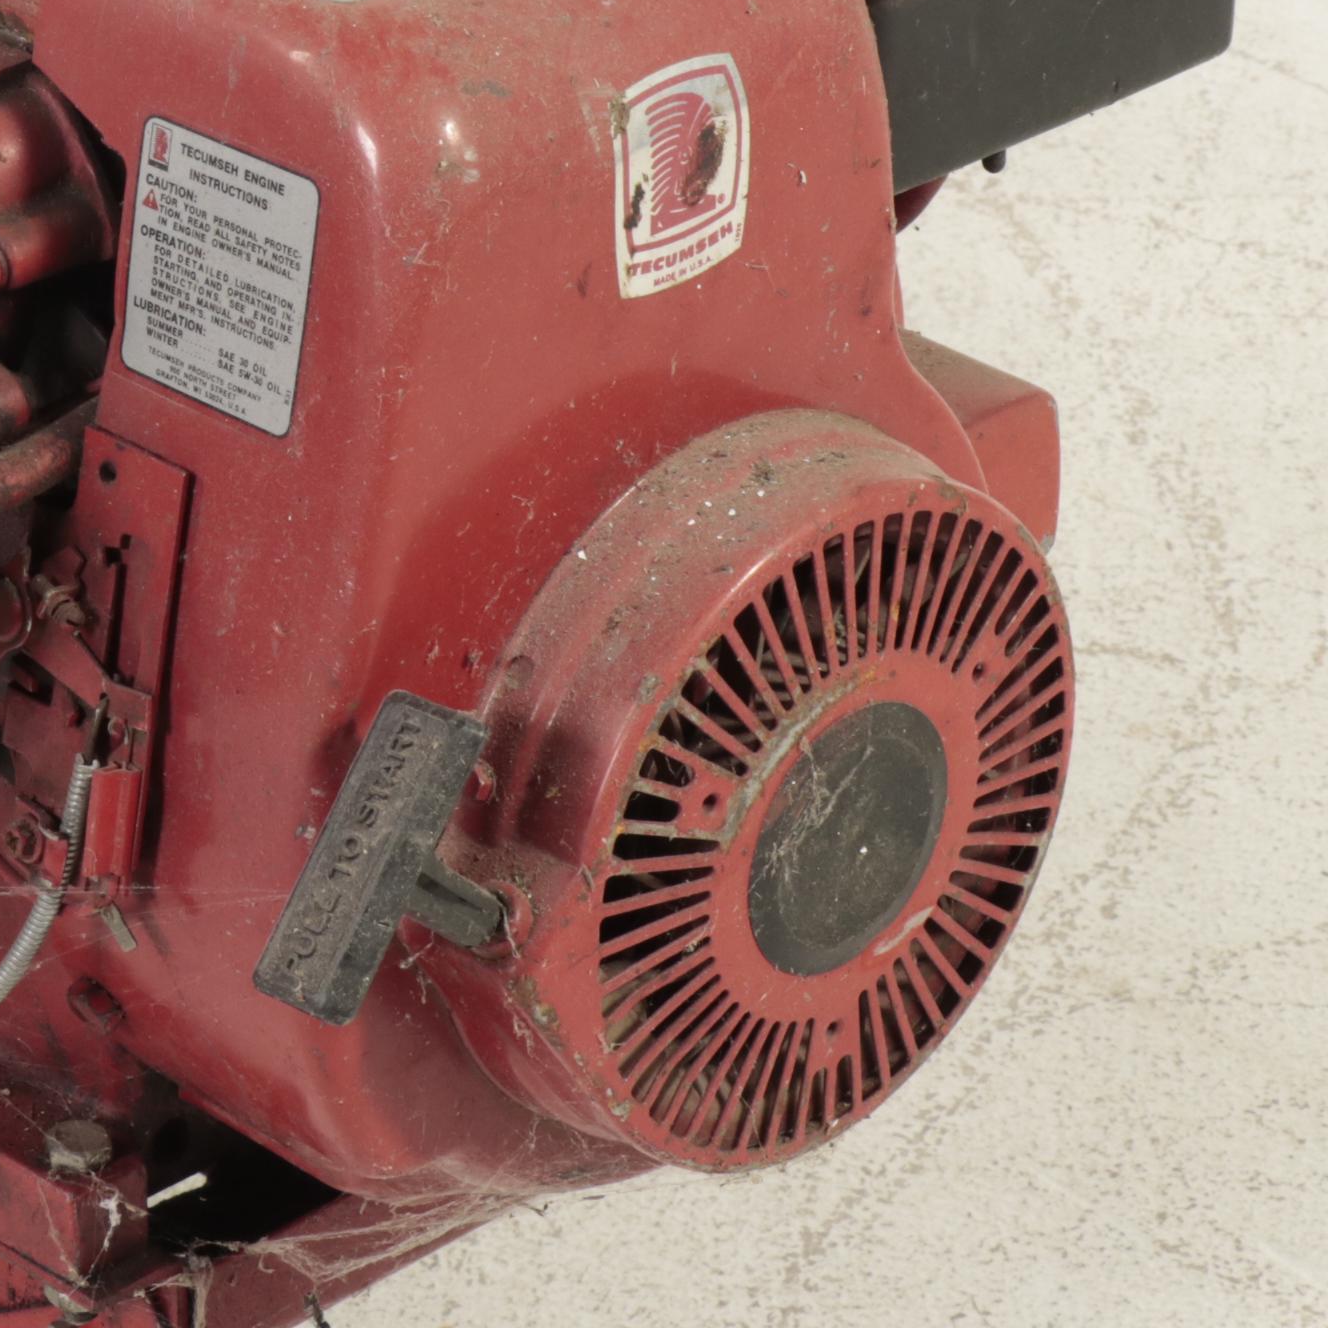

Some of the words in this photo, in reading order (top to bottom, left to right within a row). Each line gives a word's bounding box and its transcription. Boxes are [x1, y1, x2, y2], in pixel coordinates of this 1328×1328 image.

[146, 173, 198, 203] CAUTION:
[180, 143, 239, 177] TECUMSEH
[244, 169, 285, 196] ENGINE
[189, 169, 269, 210] INSTRUCTIONS
[140, 224, 207, 260] OPERATION:
[158, 216, 168, 227] IN
[173, 223, 207, 243] ENGINE
[212, 238, 252, 262] OWNER'S
[160, 193, 177, 208] FOR
[184, 203, 207, 219] YOUR
[213, 215, 258, 242] PERSONAL
[264, 237, 303, 259] PROTEC-
[188, 216, 211, 232] READ
[215, 228, 230, 242] ALL
[235, 238, 268, 257] SAFETY
[272, 253, 301, 271] NOTES
[629, 221, 734, 277] TECUMSEH
[150, 288, 174, 305] MENT
[154, 244, 172, 259] FOR
[177, 255, 229, 283] DETAILED
[235, 279, 296, 313] LUBRICATION,
[204, 279, 222, 292] AND
[227, 287, 277, 316] OPERATING
[653, 272, 676, 287] MADE
[678, 267, 688, 277] IN
[133, 295, 207, 337] LUBRICATION:
[151, 278, 190, 301] OWNER'S
[197, 297, 232, 320] MANUAL
[238, 316, 257, 330] AND
[262, 326, 292, 345] EQUIP-
[229, 299, 245, 314] SEE
[253, 310, 293, 335] ENGINE
[146, 315, 183, 339] SUMMER
[218, 348, 235, 363] SAE
[239, 357, 249, 369] 30
[252, 363, 268, 377] OIL
[146, 326, 178, 349] WINTER
[217, 359, 235, 374] SAE
[238, 368, 263, 386] 5W-30
[267, 381, 282, 395] OIL
[148, 345, 185, 368] TECUMSEH
[188, 364, 225, 387] PRODUCTS
[228, 382, 262, 403] COMPANY
[184, 372, 208, 387] NORTH
[210, 383, 238, 401] STREET
[327, 836, 363, 882] TO
[357, 720, 422, 829] START
